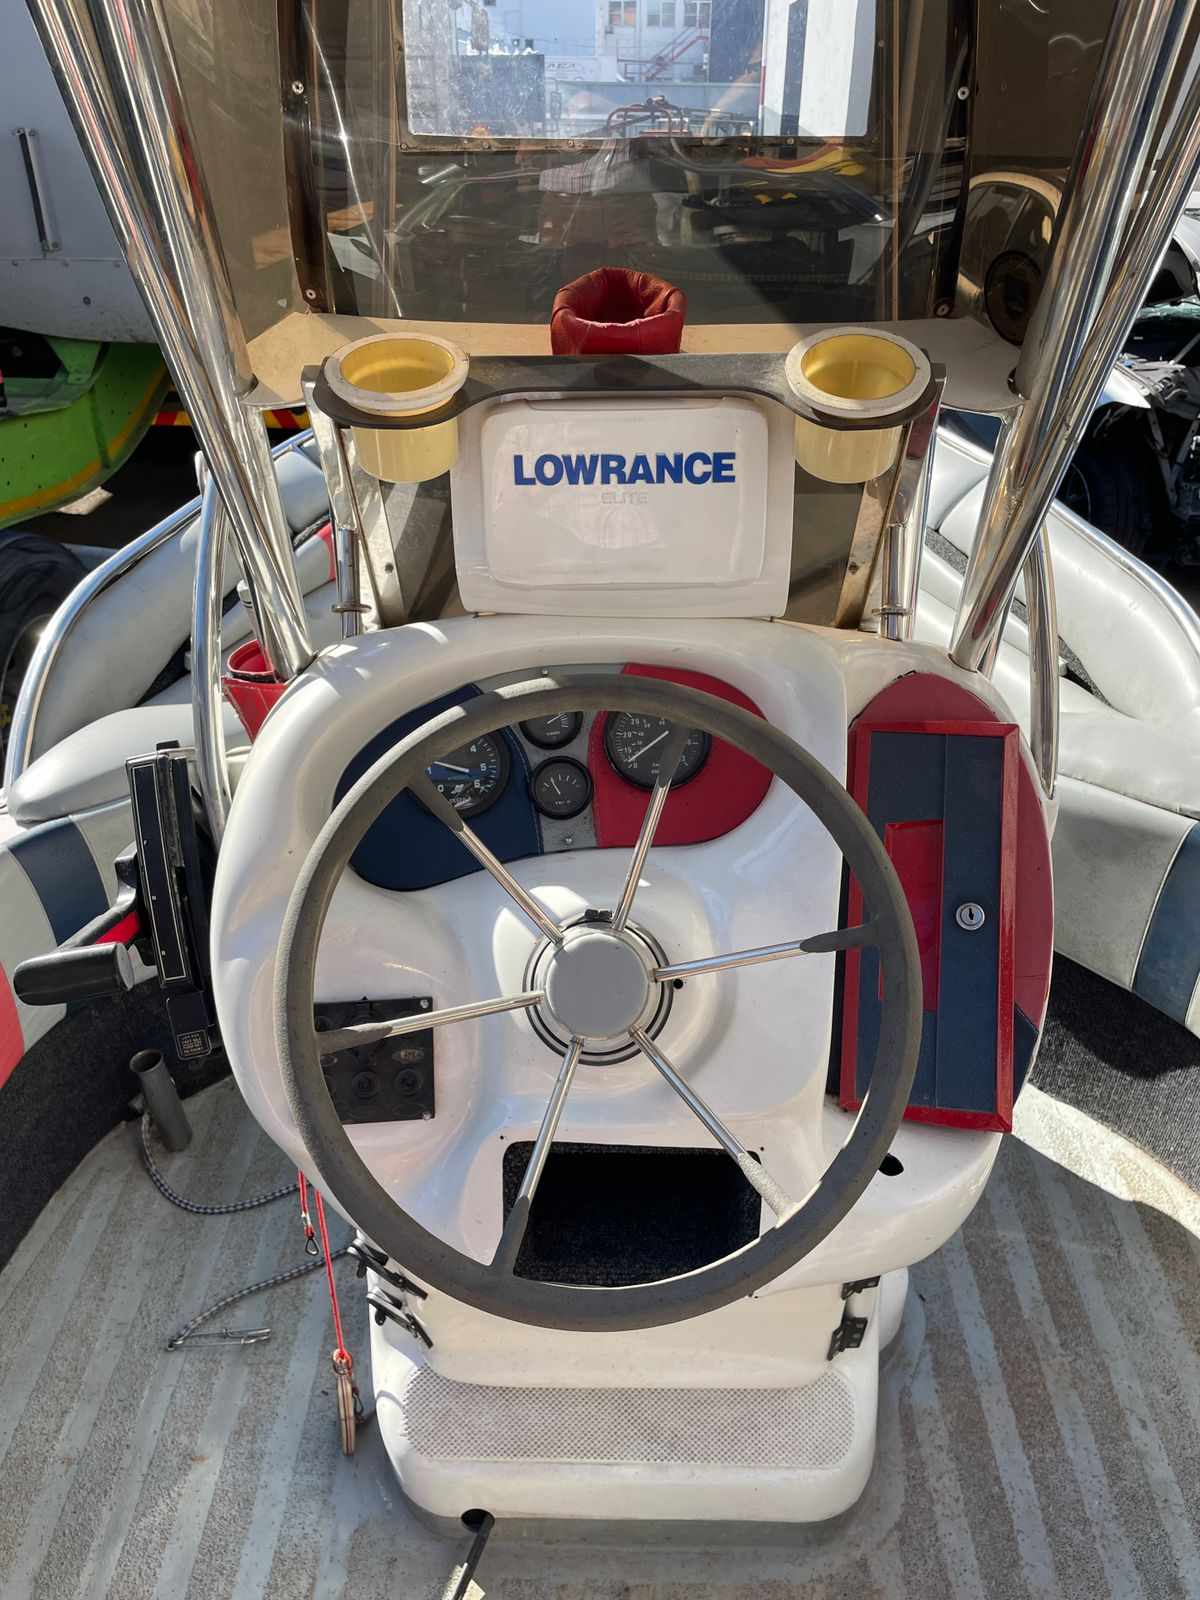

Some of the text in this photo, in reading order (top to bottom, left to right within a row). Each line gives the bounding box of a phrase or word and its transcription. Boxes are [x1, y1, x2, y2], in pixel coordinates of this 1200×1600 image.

[514, 452, 736, 486] LOWRANCE
[470, 744, 477, 752] 4
[480, 763, 487, 771] 5
[474, 779, 481, 788] 6
[437, 784, 444, 792] 0
